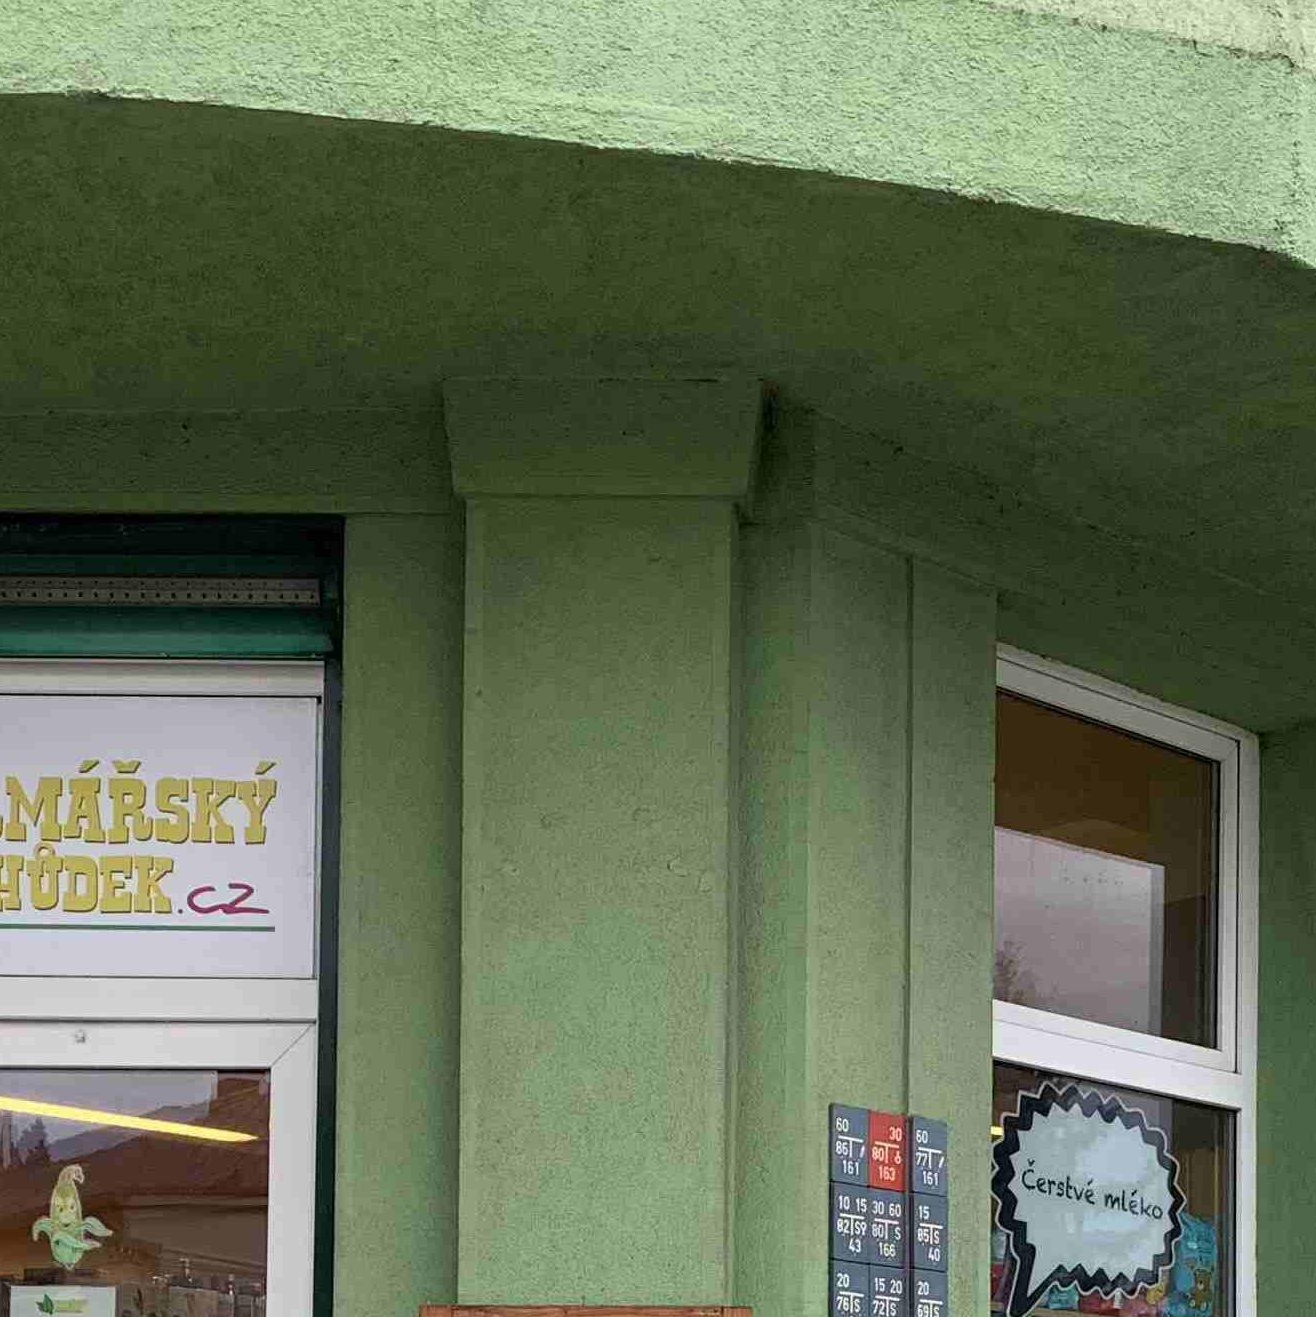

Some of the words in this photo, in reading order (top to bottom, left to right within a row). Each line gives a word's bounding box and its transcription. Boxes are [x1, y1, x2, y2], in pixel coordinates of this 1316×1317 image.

[836, 1117, 849, 1132] 60
[889, 1127, 902, 1141] 30
[916, 1130, 928, 1144] 60
[915, 1152, 928, 1166] 77
[843, 1160, 860, 1175] 161
[1021, 1158, 1095, 1205] Čerstvé
[1104, 1189, 1163, 1219] mléko
[839, 1195, 850, 1210] 10
[856, 1198, 867, 1212] 15
[872, 1201, 884, 1214] 30
[918, 1205, 930, 1220] 15
[928, 1247, 940, 1262] 40
[836, 1273, 849, 1288] 20
[875, 1277, 885, 1292] 15
[890, 1279, 903, 1294] 20
[917, 1281, 929, 1296] 20
